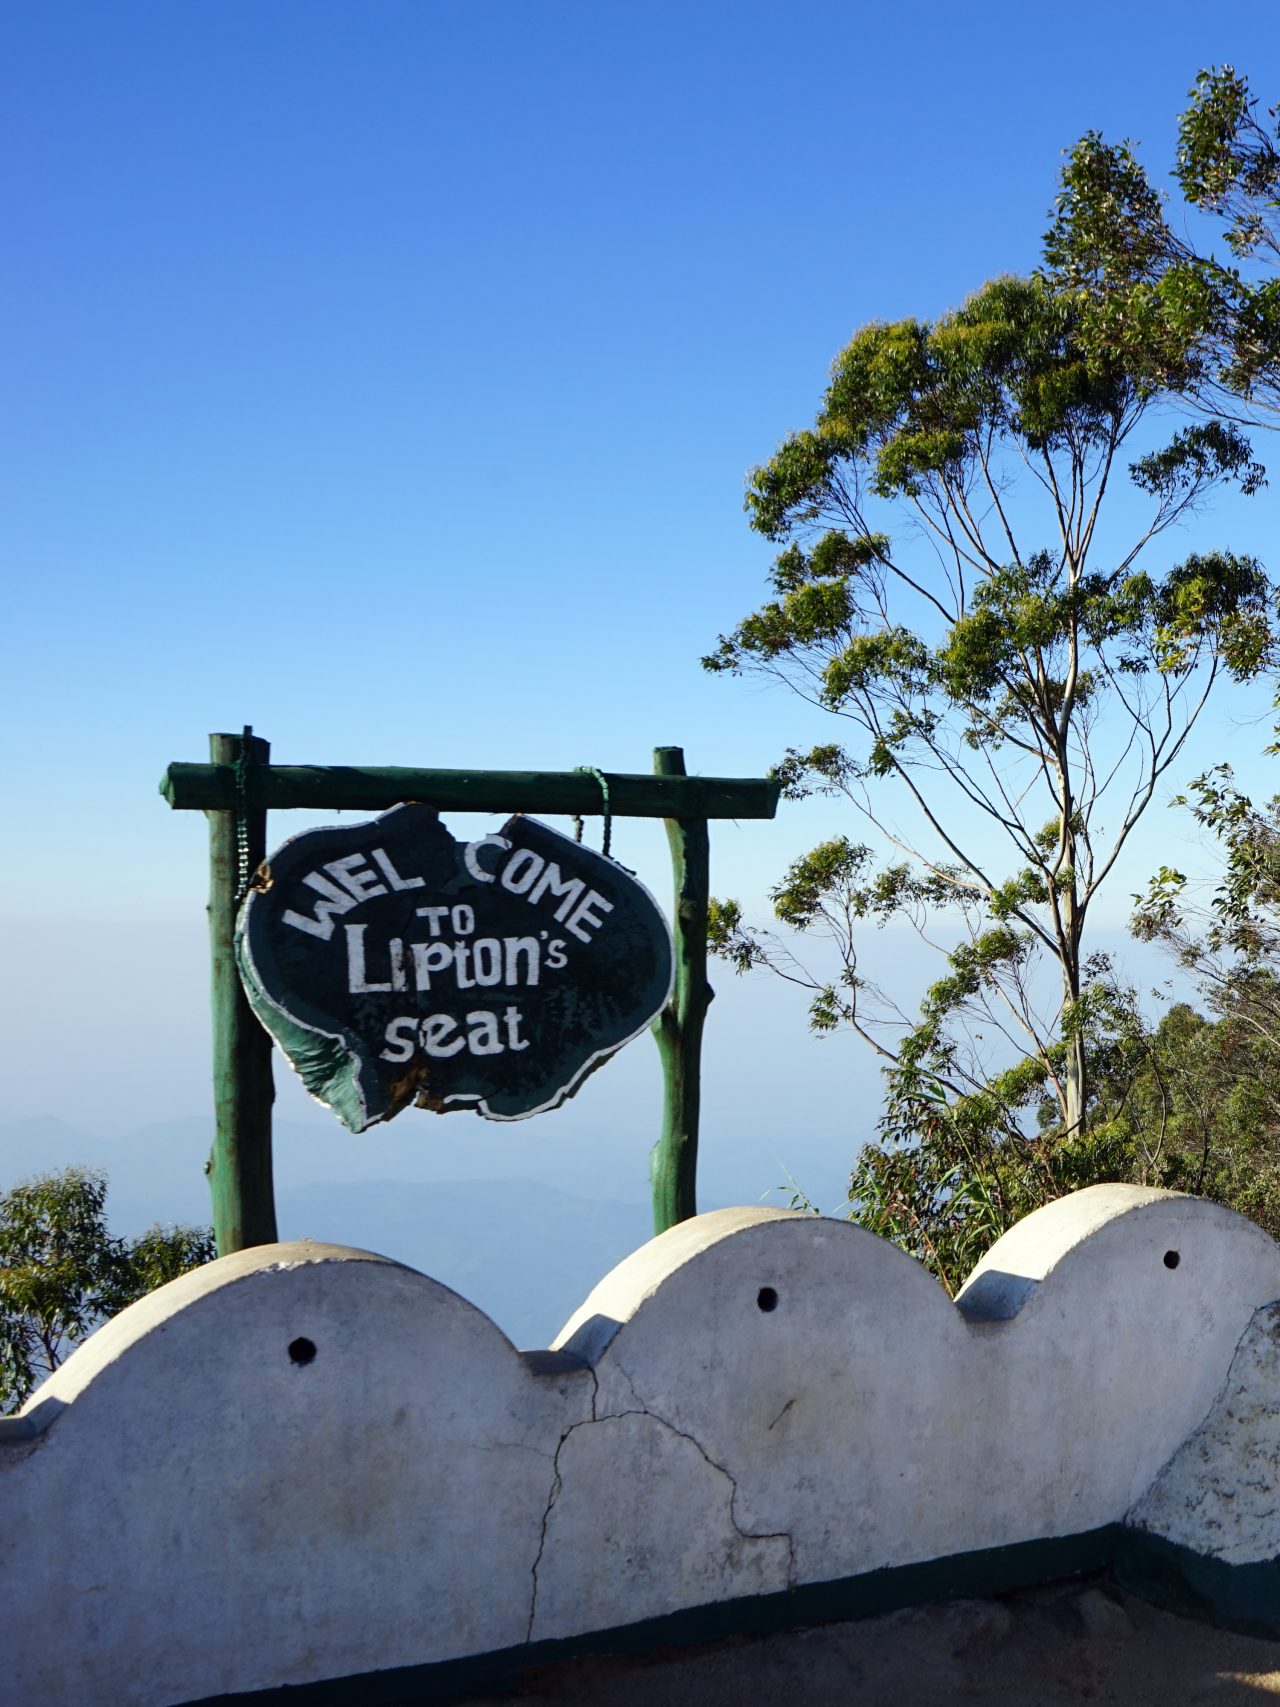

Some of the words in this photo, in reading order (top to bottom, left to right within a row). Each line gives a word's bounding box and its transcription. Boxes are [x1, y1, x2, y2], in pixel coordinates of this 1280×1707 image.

[281, 848, 426, 941] WEL
[464, 833, 614, 944] COME
[415, 904, 475, 937] TO
[379, 1006, 530, 1063] seat
